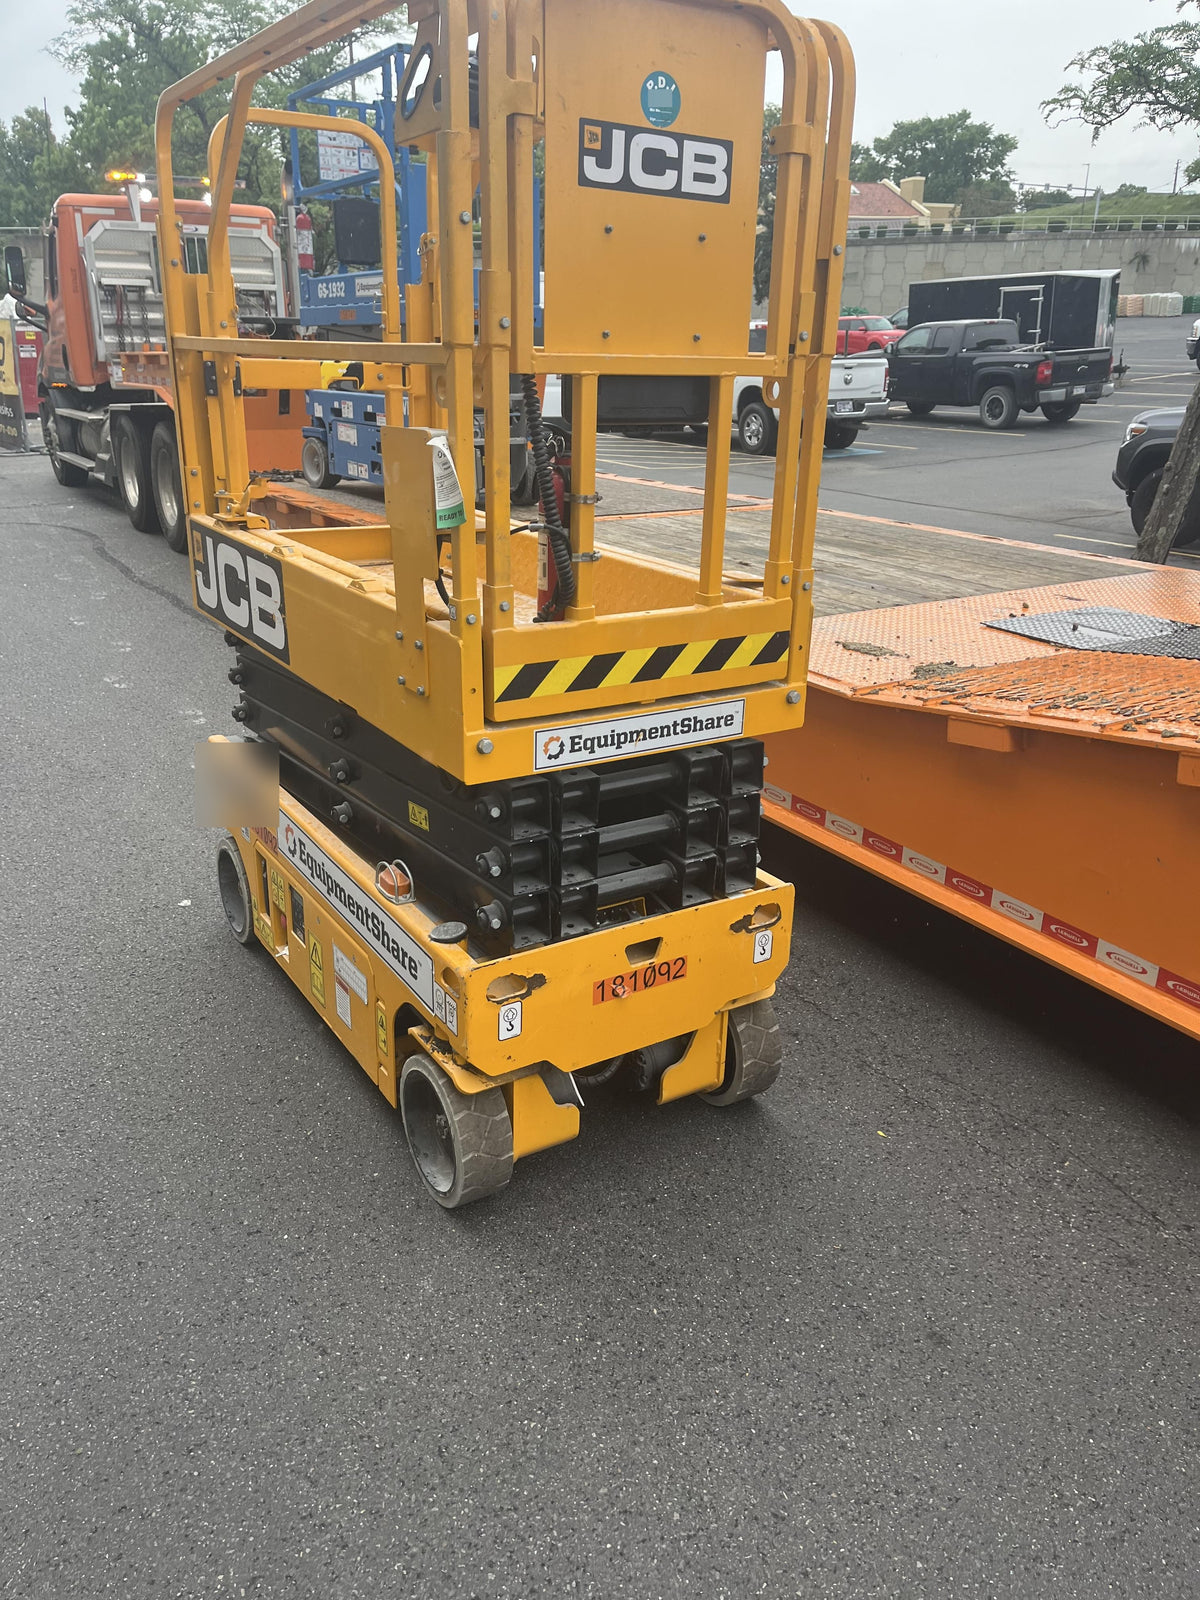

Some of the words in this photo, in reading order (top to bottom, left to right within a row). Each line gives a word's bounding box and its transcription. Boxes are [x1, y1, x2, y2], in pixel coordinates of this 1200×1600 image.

[584, 129, 727, 196] JCB
[318, 281, 345, 298] GS-1932
[196, 536, 286, 650] JCB
[569, 713, 735, 754] EquipmentShare
[297, 838, 419, 979] EquipmentShare
[596, 956, 687, 1003] 181092
